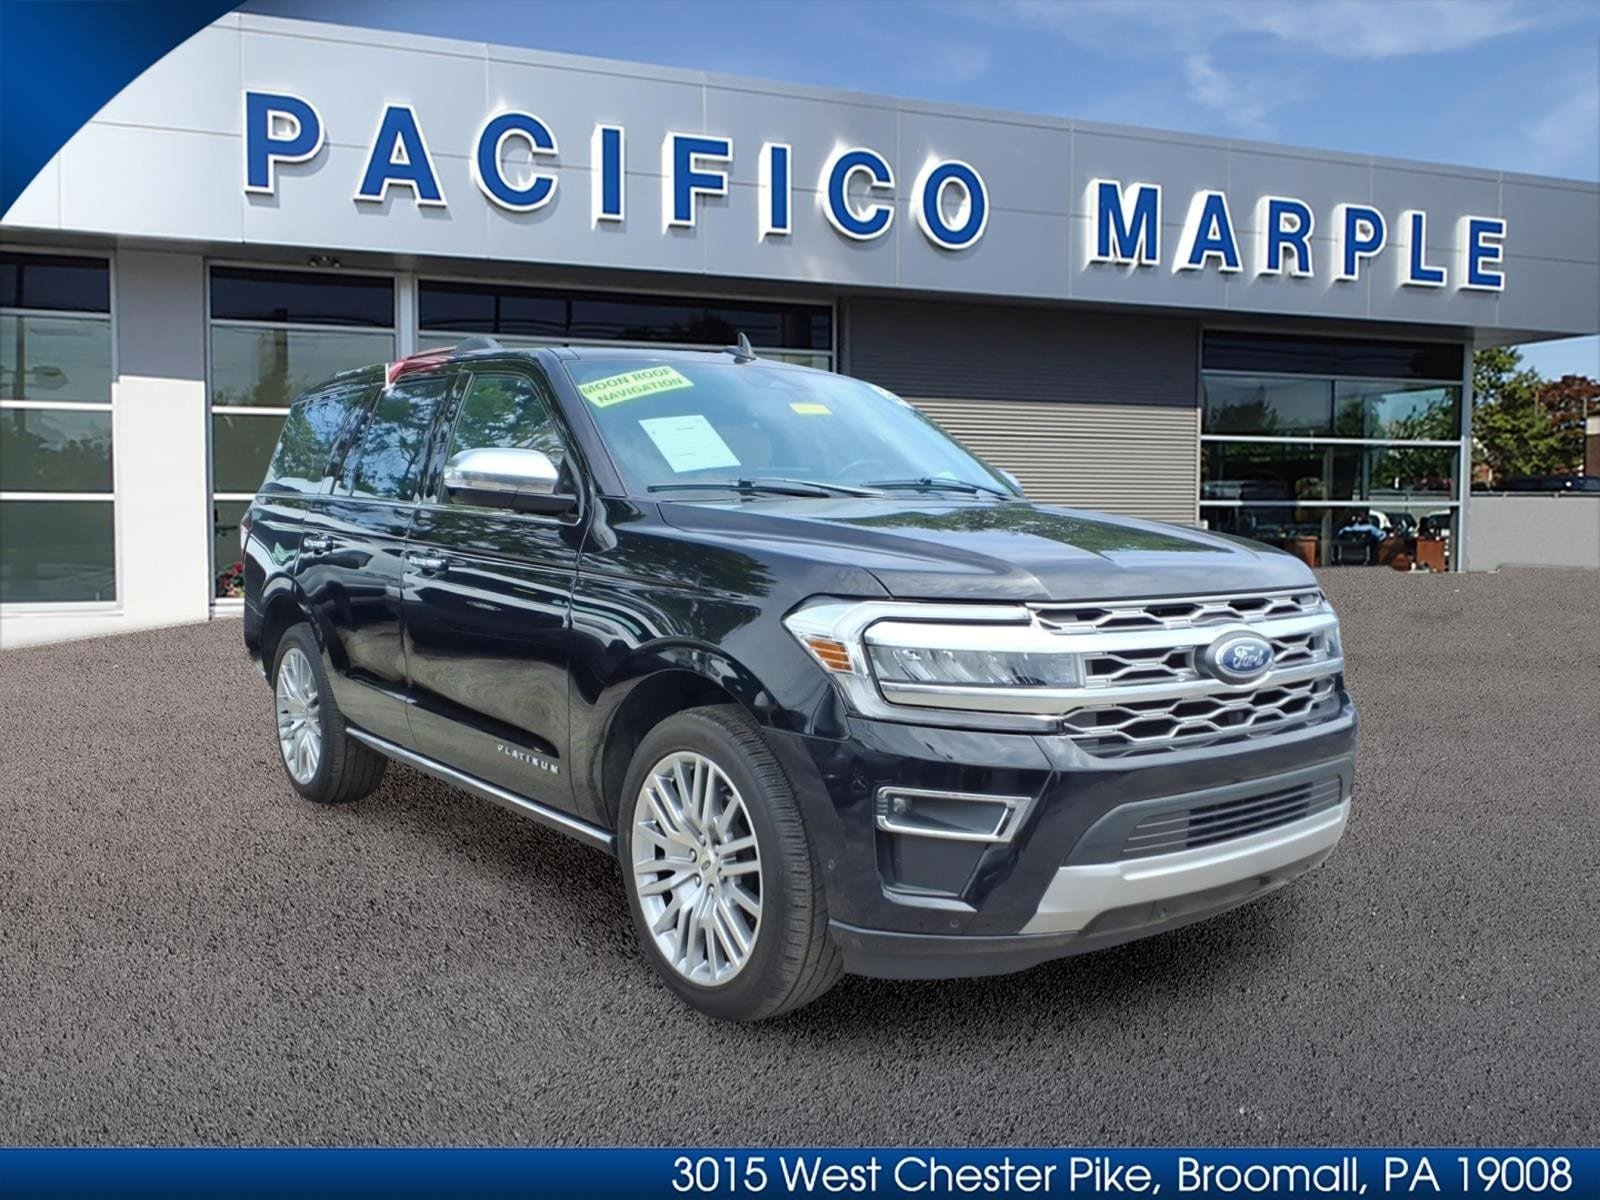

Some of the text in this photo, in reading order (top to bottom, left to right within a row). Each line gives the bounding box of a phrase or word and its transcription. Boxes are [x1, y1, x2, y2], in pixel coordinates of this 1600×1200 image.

[242, 89, 1507, 291] PACIFICO MARPLE
[581, 368, 670, 395] MOON ROOF
[598, 378, 683, 403] NAVIGATION
[1233, 646, 1264, 669] Ford
[497, 744, 559, 775] PLATINUM
